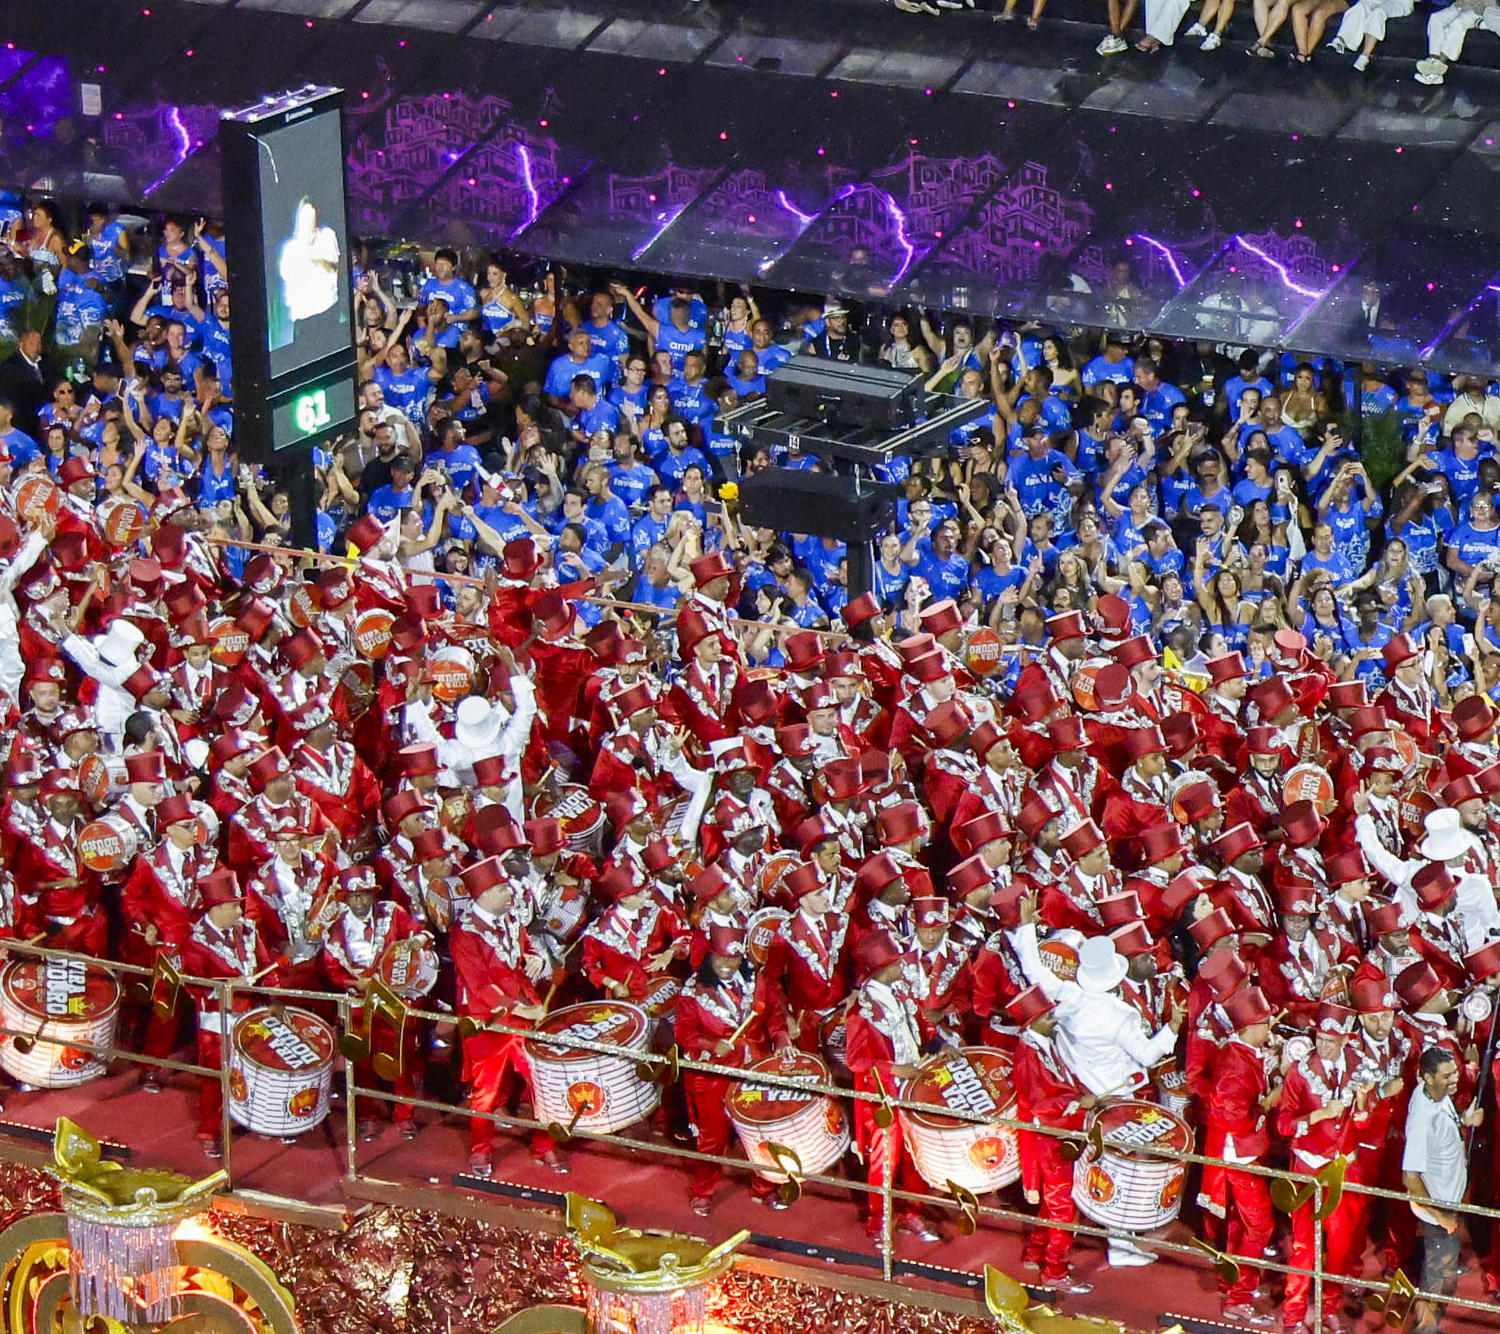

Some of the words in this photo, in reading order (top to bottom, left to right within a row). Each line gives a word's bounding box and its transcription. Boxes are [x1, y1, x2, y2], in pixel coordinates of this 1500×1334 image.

[296, 392, 332, 430] 61
[67, 959, 87, 995] VIRA
[261, 1016, 319, 1066] DOURO
[267, 1036, 300, 1070] VIRA
